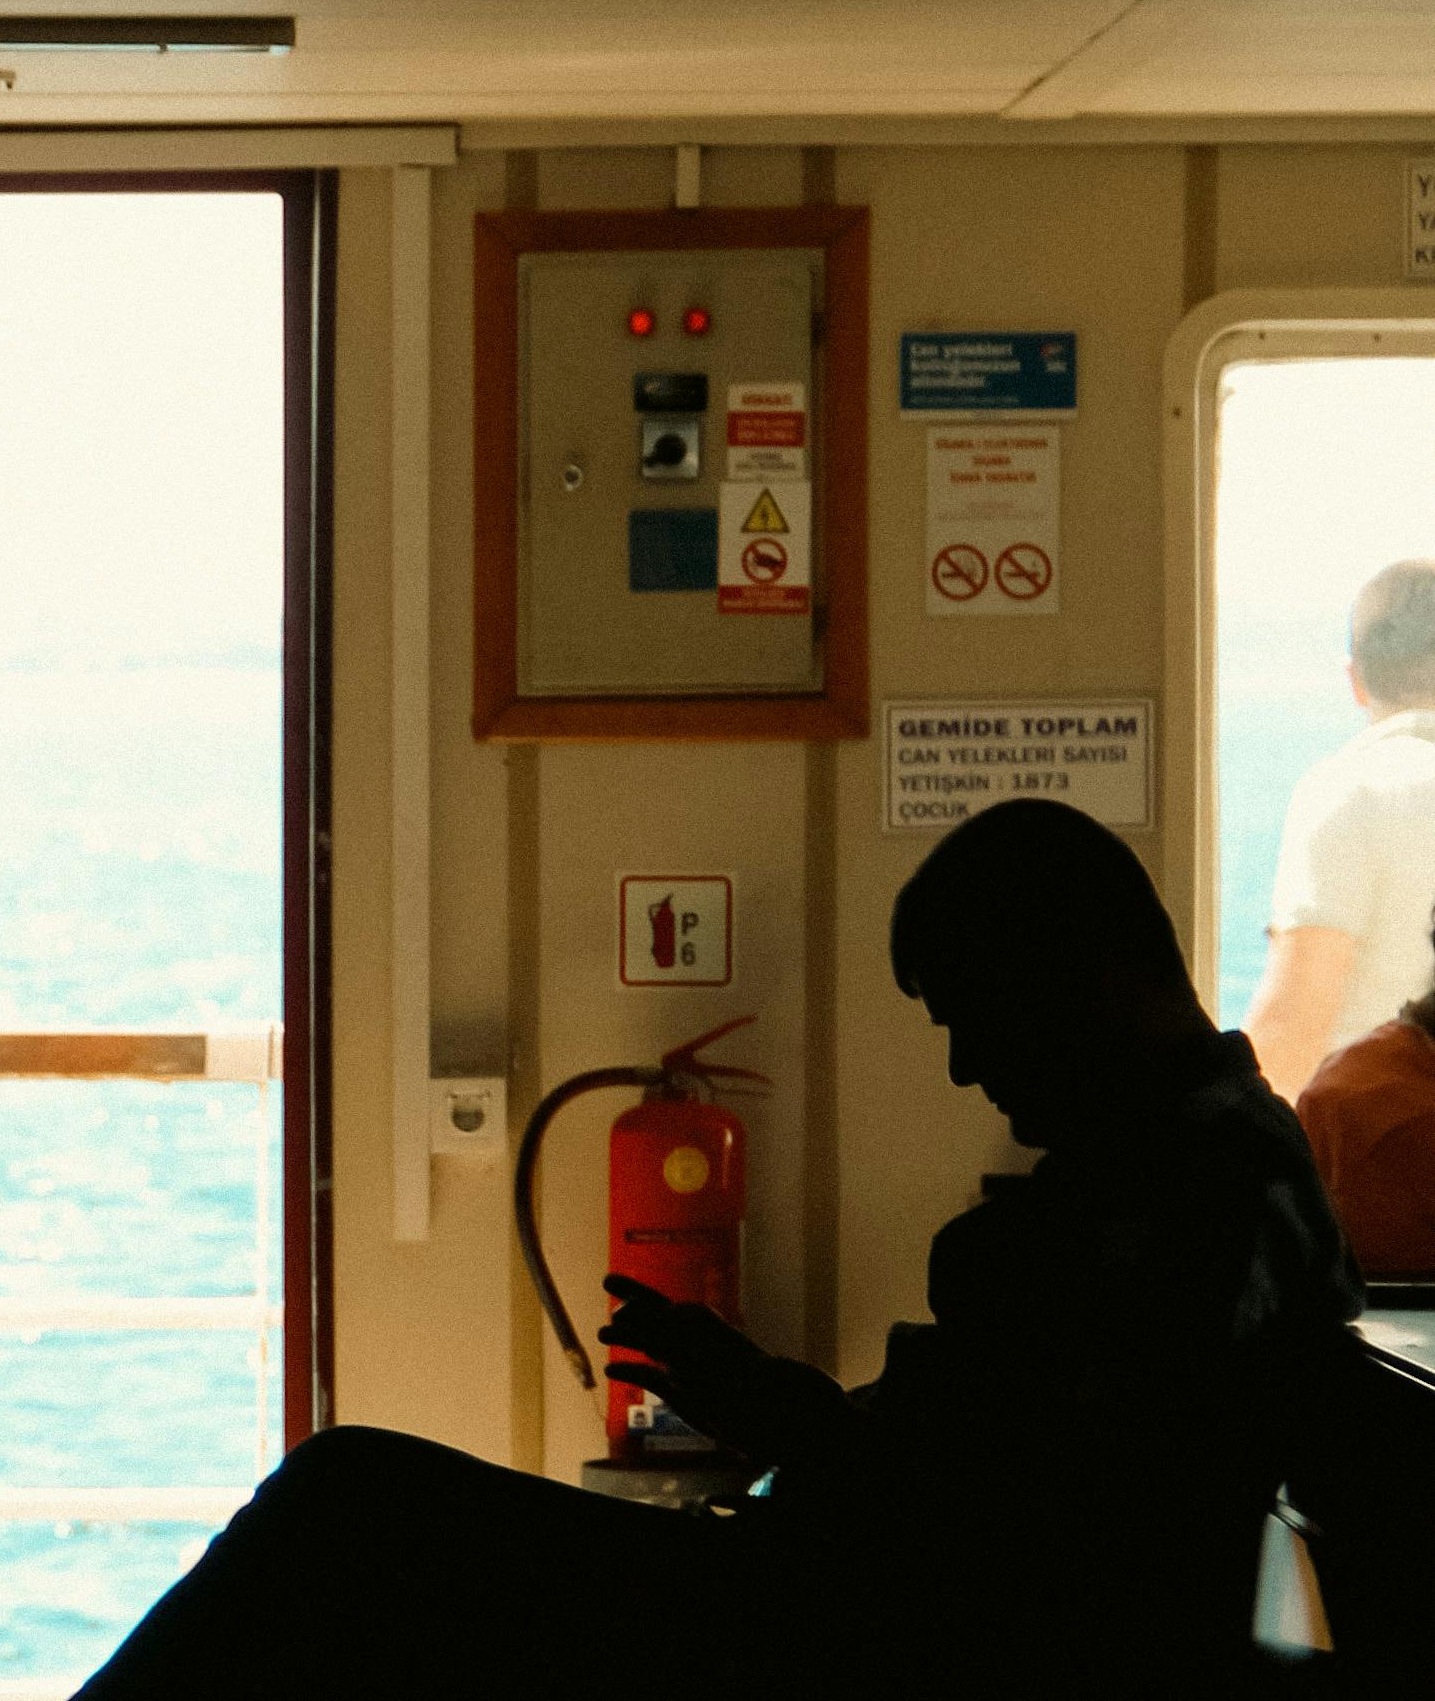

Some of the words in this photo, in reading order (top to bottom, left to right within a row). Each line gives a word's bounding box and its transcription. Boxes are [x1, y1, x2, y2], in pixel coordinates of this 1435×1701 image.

[898, 713, 1010, 738] GEMİDE
[1020, 716, 1138, 737] TOPLAM
[898, 747, 940, 765] CAN
[898, 802, 970, 823] ÇOCUK
[681, 912, 699, 936] P
[680, 941, 697, 967] 6
